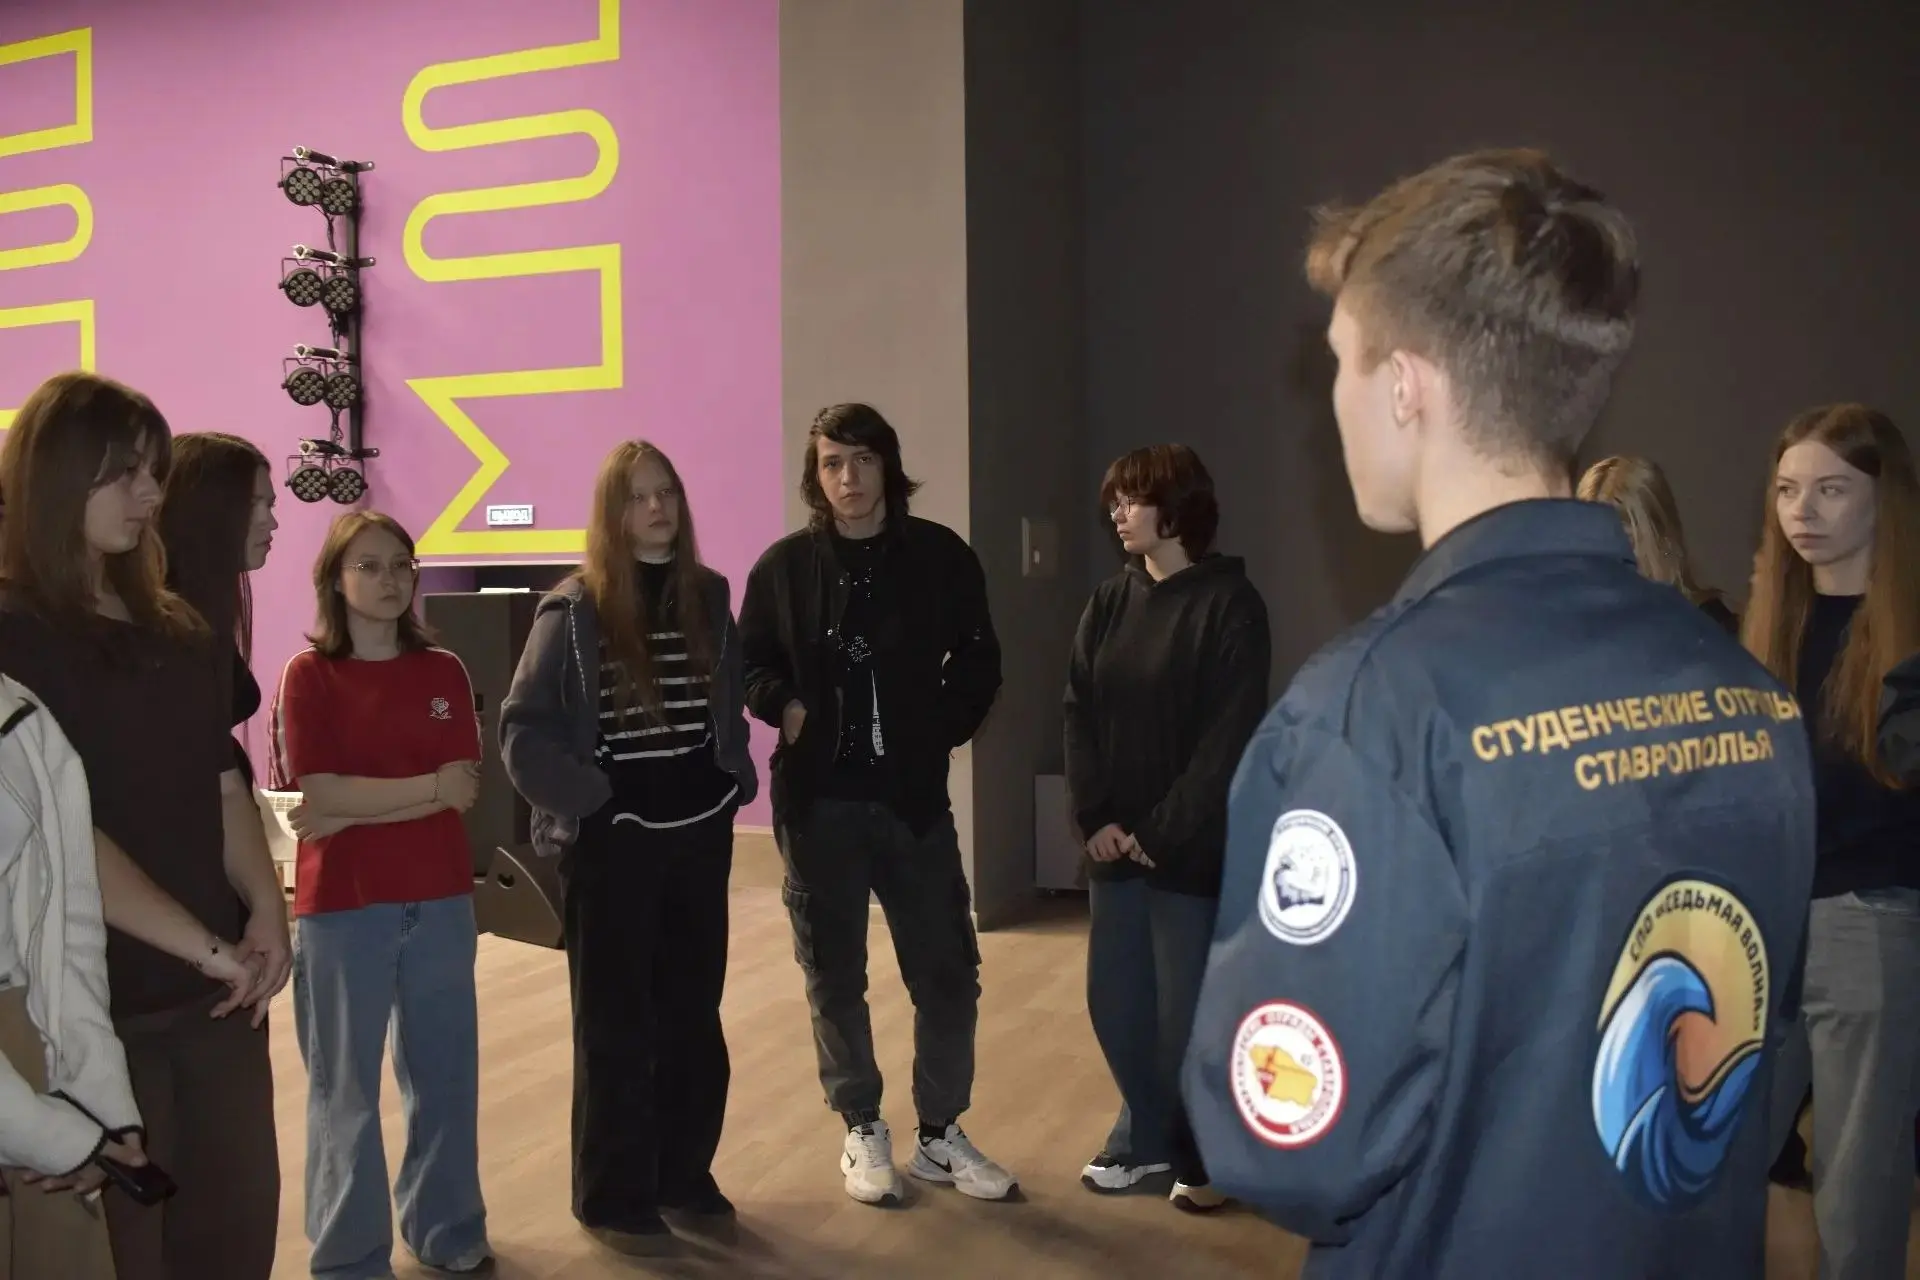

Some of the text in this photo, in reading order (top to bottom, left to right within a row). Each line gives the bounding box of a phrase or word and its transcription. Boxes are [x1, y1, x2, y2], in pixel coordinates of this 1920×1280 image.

[1471, 690, 1713, 761] СТУДЕНЧЕСКИЕ
[1574, 729, 1773, 790] СТАВРОПОЛЬЯ
[1630, 913, 1654, 962] СПО
